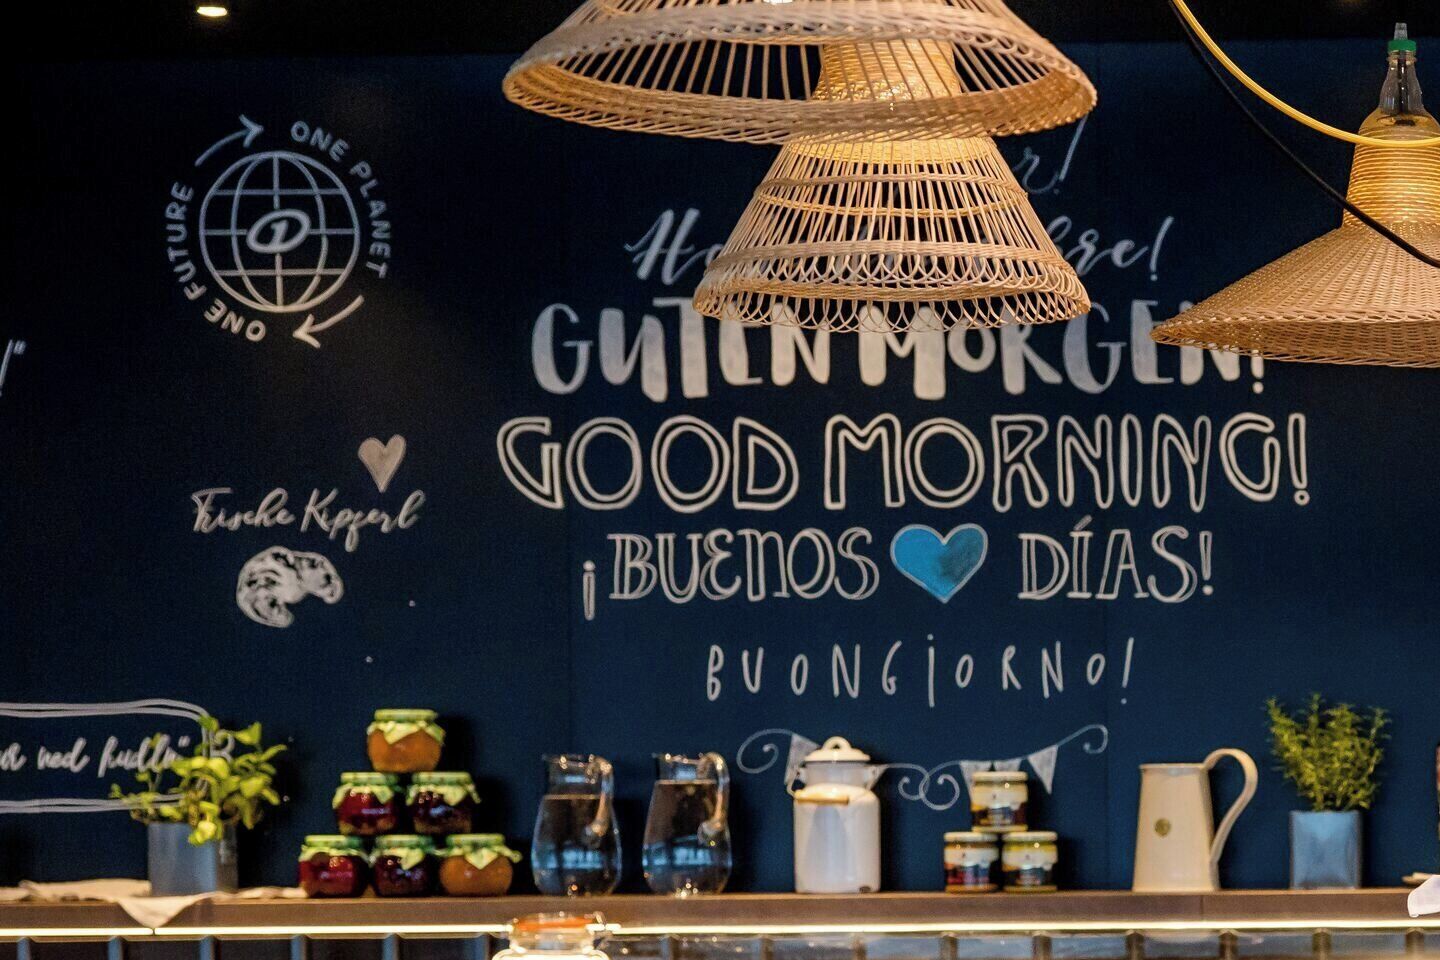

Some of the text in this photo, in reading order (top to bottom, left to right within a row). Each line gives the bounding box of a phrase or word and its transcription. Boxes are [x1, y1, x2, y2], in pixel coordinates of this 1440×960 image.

[165, 181, 267, 342] ONE FUTURE
[290, 120, 392, 279] ONE PLANET
[496, 412, 1310, 513] GOOD MORNING!
